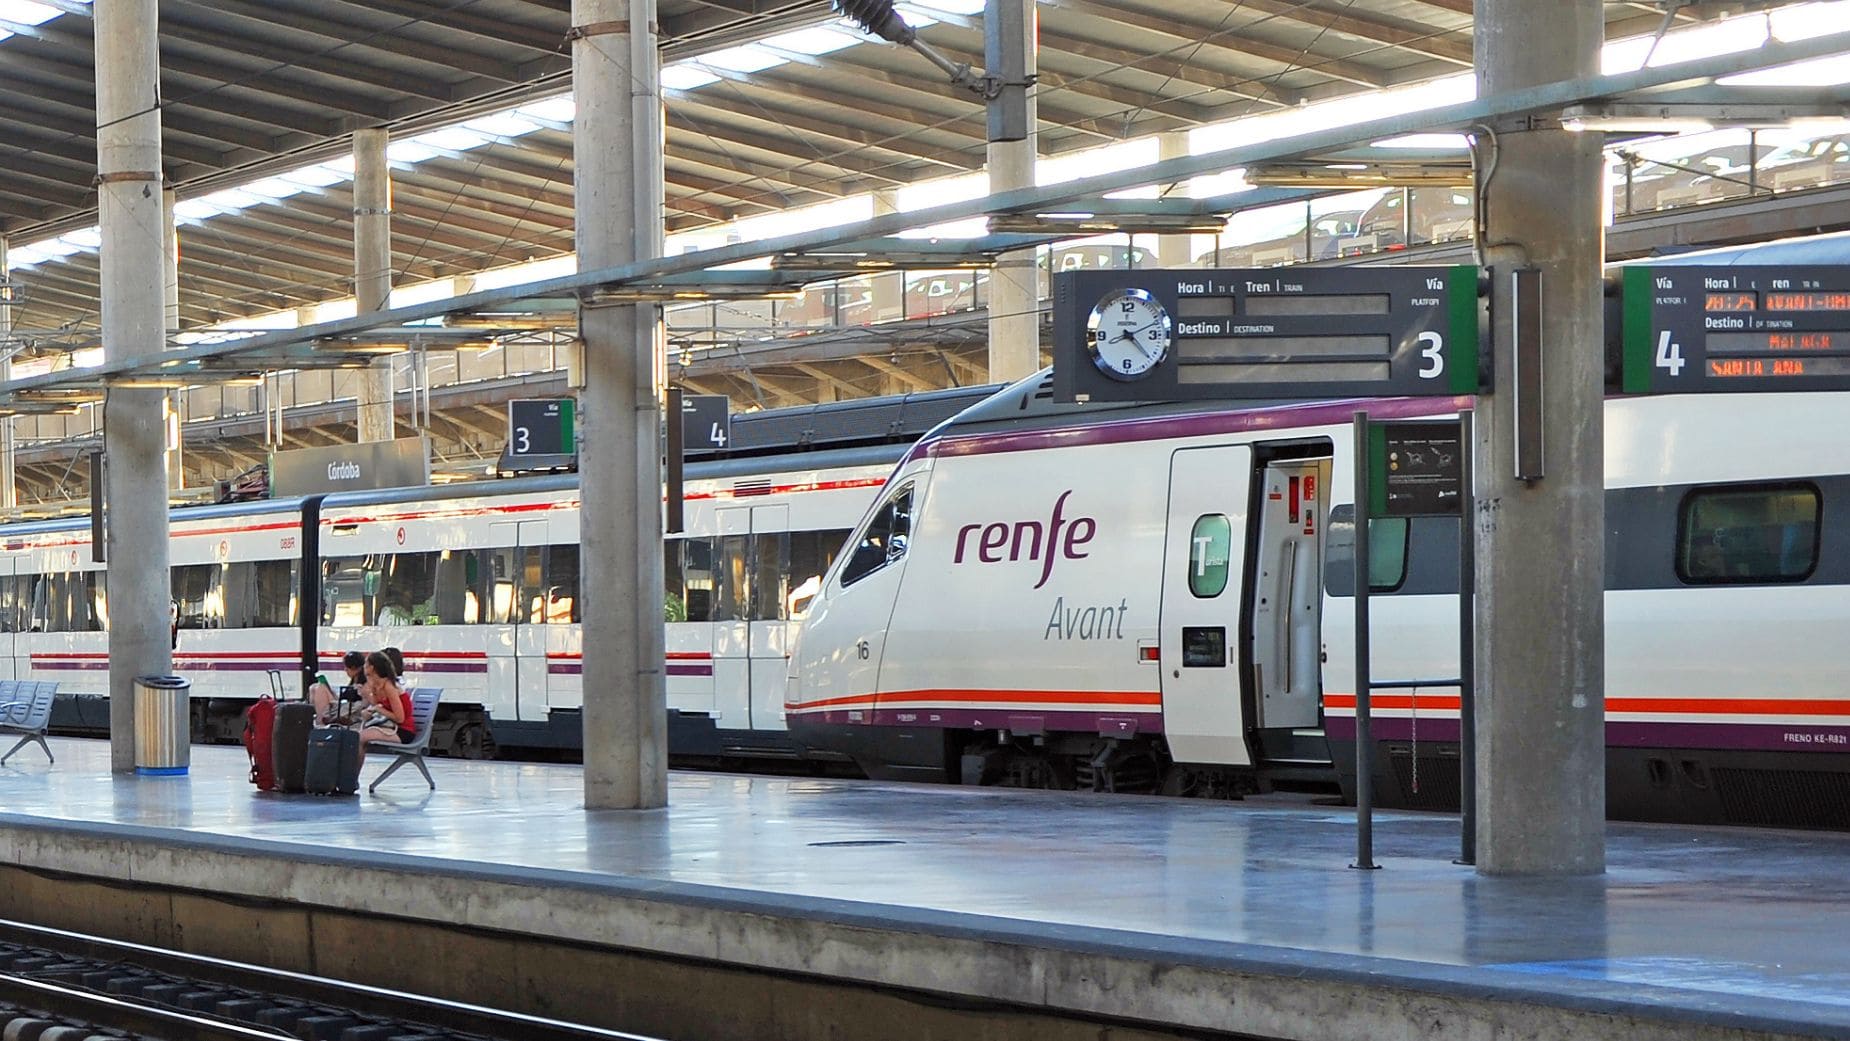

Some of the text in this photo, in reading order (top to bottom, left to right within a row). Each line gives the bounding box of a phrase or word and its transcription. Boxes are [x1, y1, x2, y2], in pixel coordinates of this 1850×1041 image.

[1178, 282, 1204, 294] Hora
[1246, 281, 1270, 292] Tren
[1426, 278, 1443, 290] Vía
[1656, 277, 1672, 289] Vía
[1704, 278, 1729, 289] Hora
[1122, 303, 1135, 312] 12
[1178, 322, 1274, 334] Destino DESTINATION
[1705, 317, 1744, 328] Destino
[1098, 331, 1106, 341] 9
[1149, 330, 1157, 340] 3
[1419, 331, 1444, 379] 3
[1656, 331, 1685, 376] 4
[1123, 359, 1131, 369] 6
[516, 427, 529, 453] 3
[711, 422, 726, 447] 4
[327, 461, 360, 480] Córdoba
[954, 489, 1097, 589] renfe
[1044, 596, 1127, 640] Avant
[857, 641, 869, 660] 16
[1784, 733, 1812, 743] FRENO
